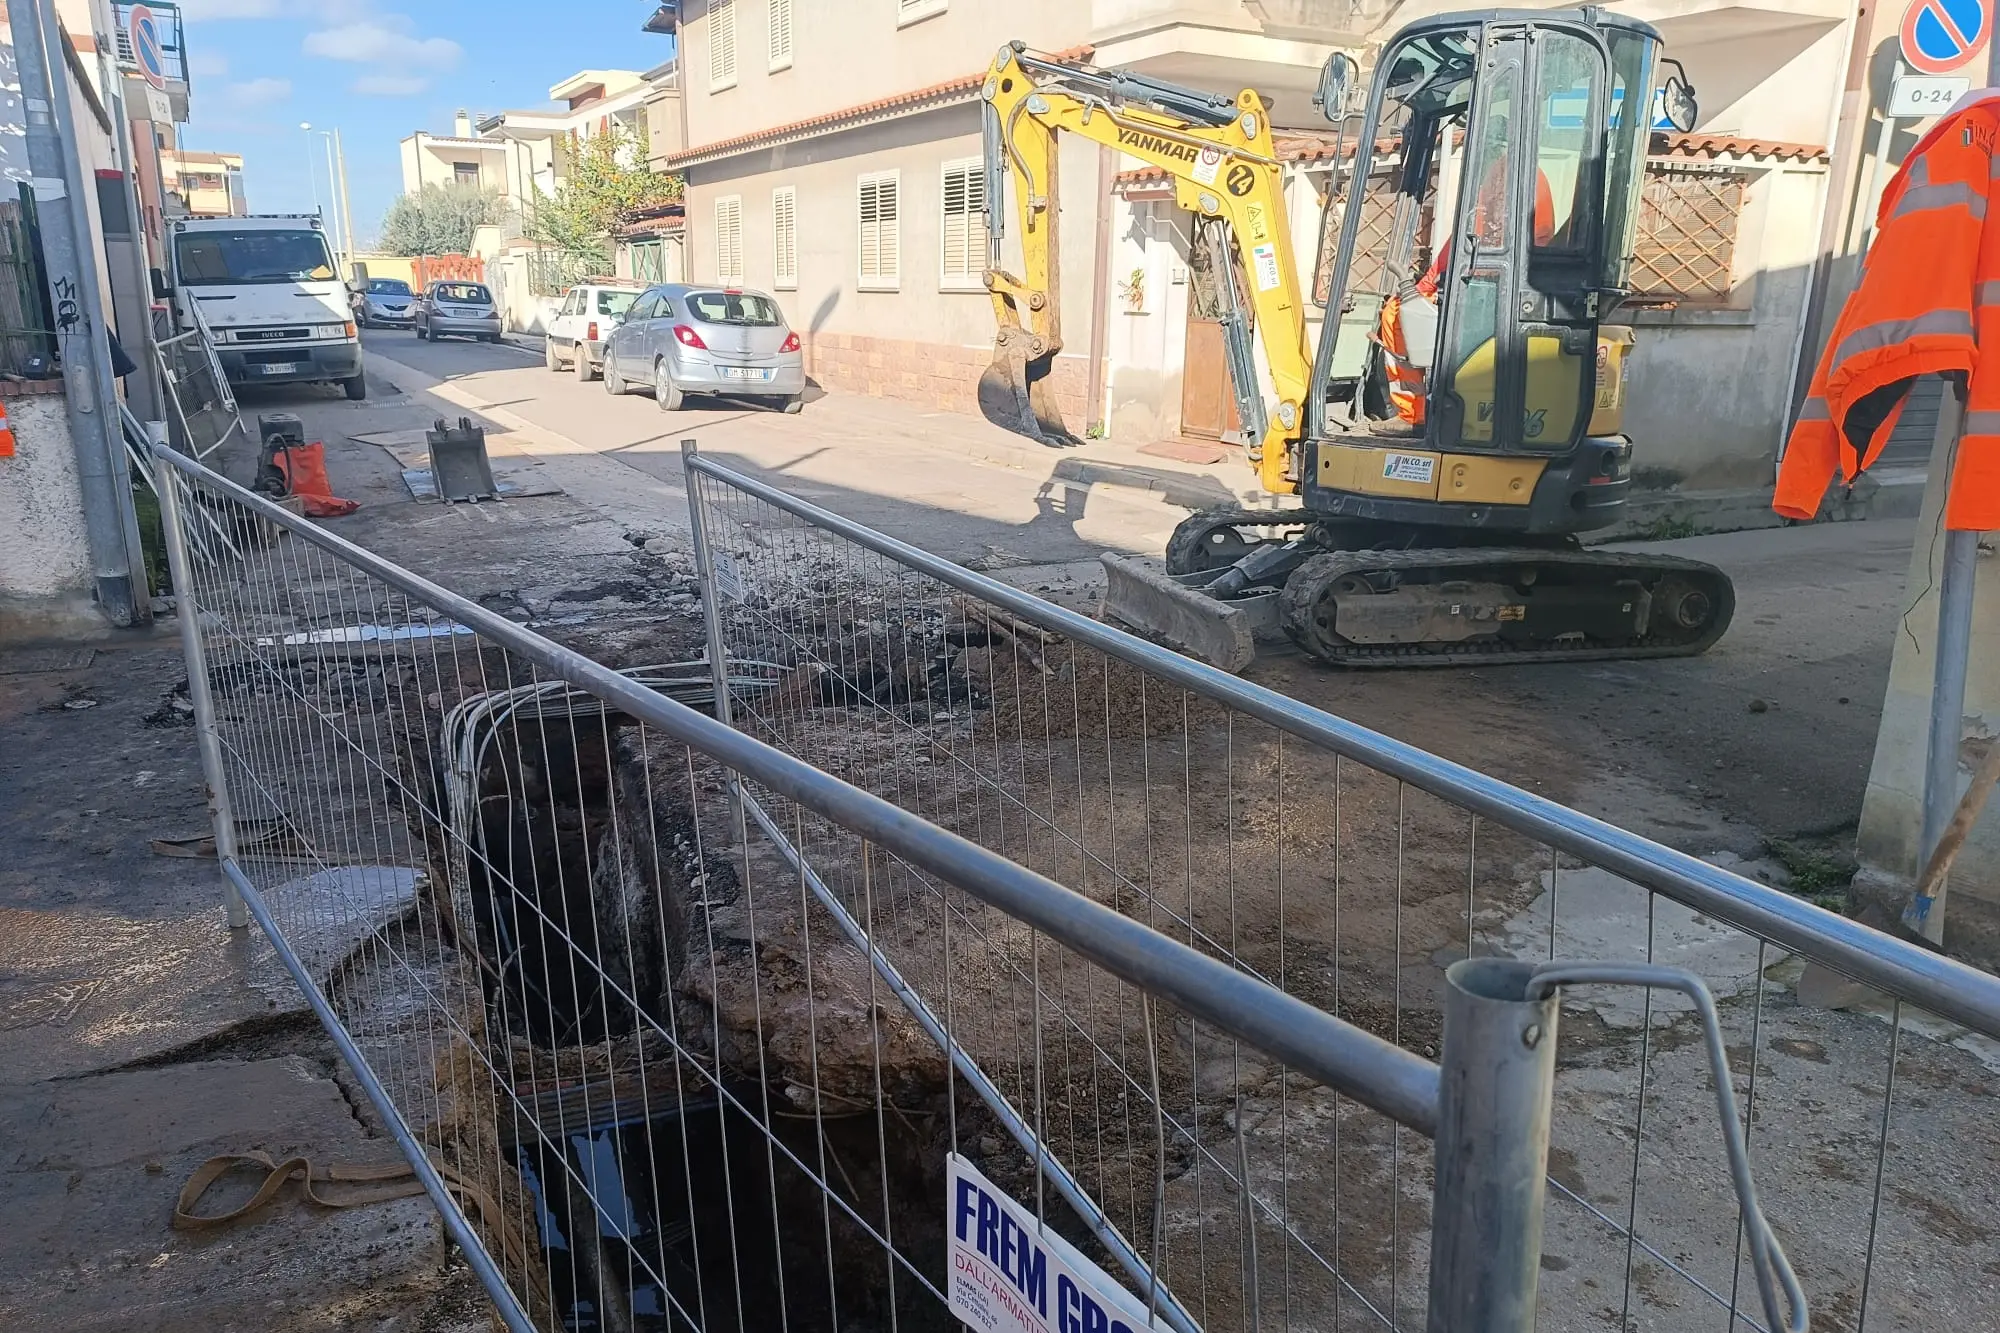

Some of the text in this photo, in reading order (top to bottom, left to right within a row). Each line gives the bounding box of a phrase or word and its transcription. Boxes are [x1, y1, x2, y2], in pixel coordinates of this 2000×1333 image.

[1911, 90, 1952, 103] 0-24
[1117, 127, 1199, 163] YANMAR
[956, 1175, 1047, 1320] FREM
[955, 1253, 1043, 1333] DALL'ARMATU
[956, 1285, 966, 1297] Via
[956, 1276, 989, 1307] ELMAS (CA)
[956, 1296, 969, 1309] 070
